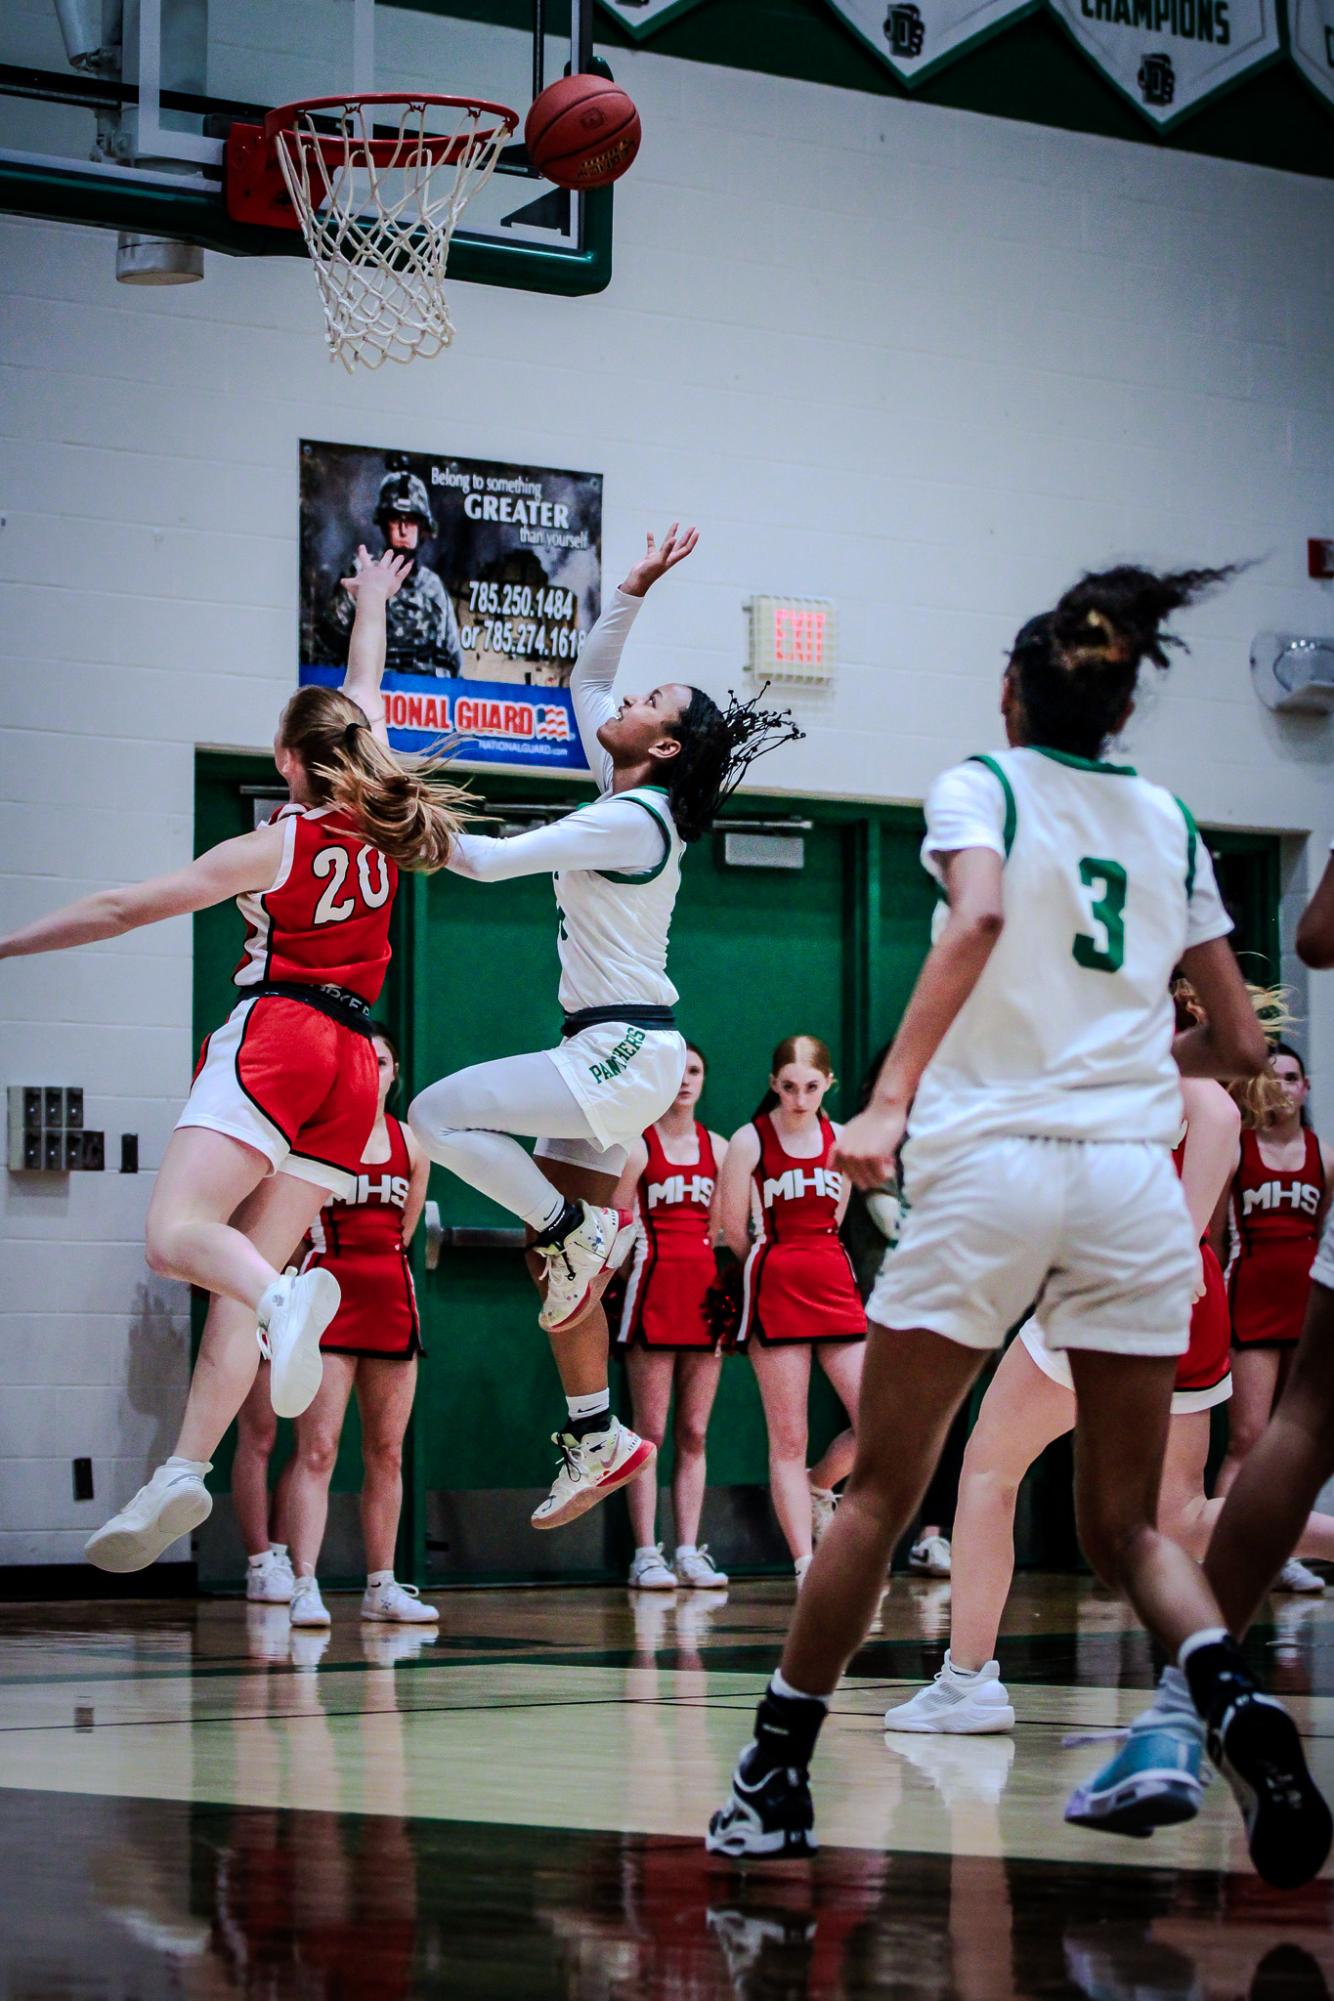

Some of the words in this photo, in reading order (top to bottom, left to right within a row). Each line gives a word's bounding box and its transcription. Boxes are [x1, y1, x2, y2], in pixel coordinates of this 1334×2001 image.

[431, 467, 470, 494] Belong
[472, 474, 484, 490] to
[486, 475, 542, 500] something
[464, 493, 569, 529] GREATER
[520, 523, 544, 543] than
[545, 529, 589, 549] yourself
[469, 581, 573, 620] 785.250.1484
[461, 625, 480, 648] or
[381, 694, 451, 729] IONAL
[457, 700, 534, 736] GUARD
[313, 845, 390, 924] 20
[1072, 857, 1127, 974] 3
[589, 1027, 646, 1084] PANTHERS
[648, 1174, 715, 1209] MHS
[763, 1167, 844, 1209] MHS
[1243, 1180, 1320, 1216] MHS
